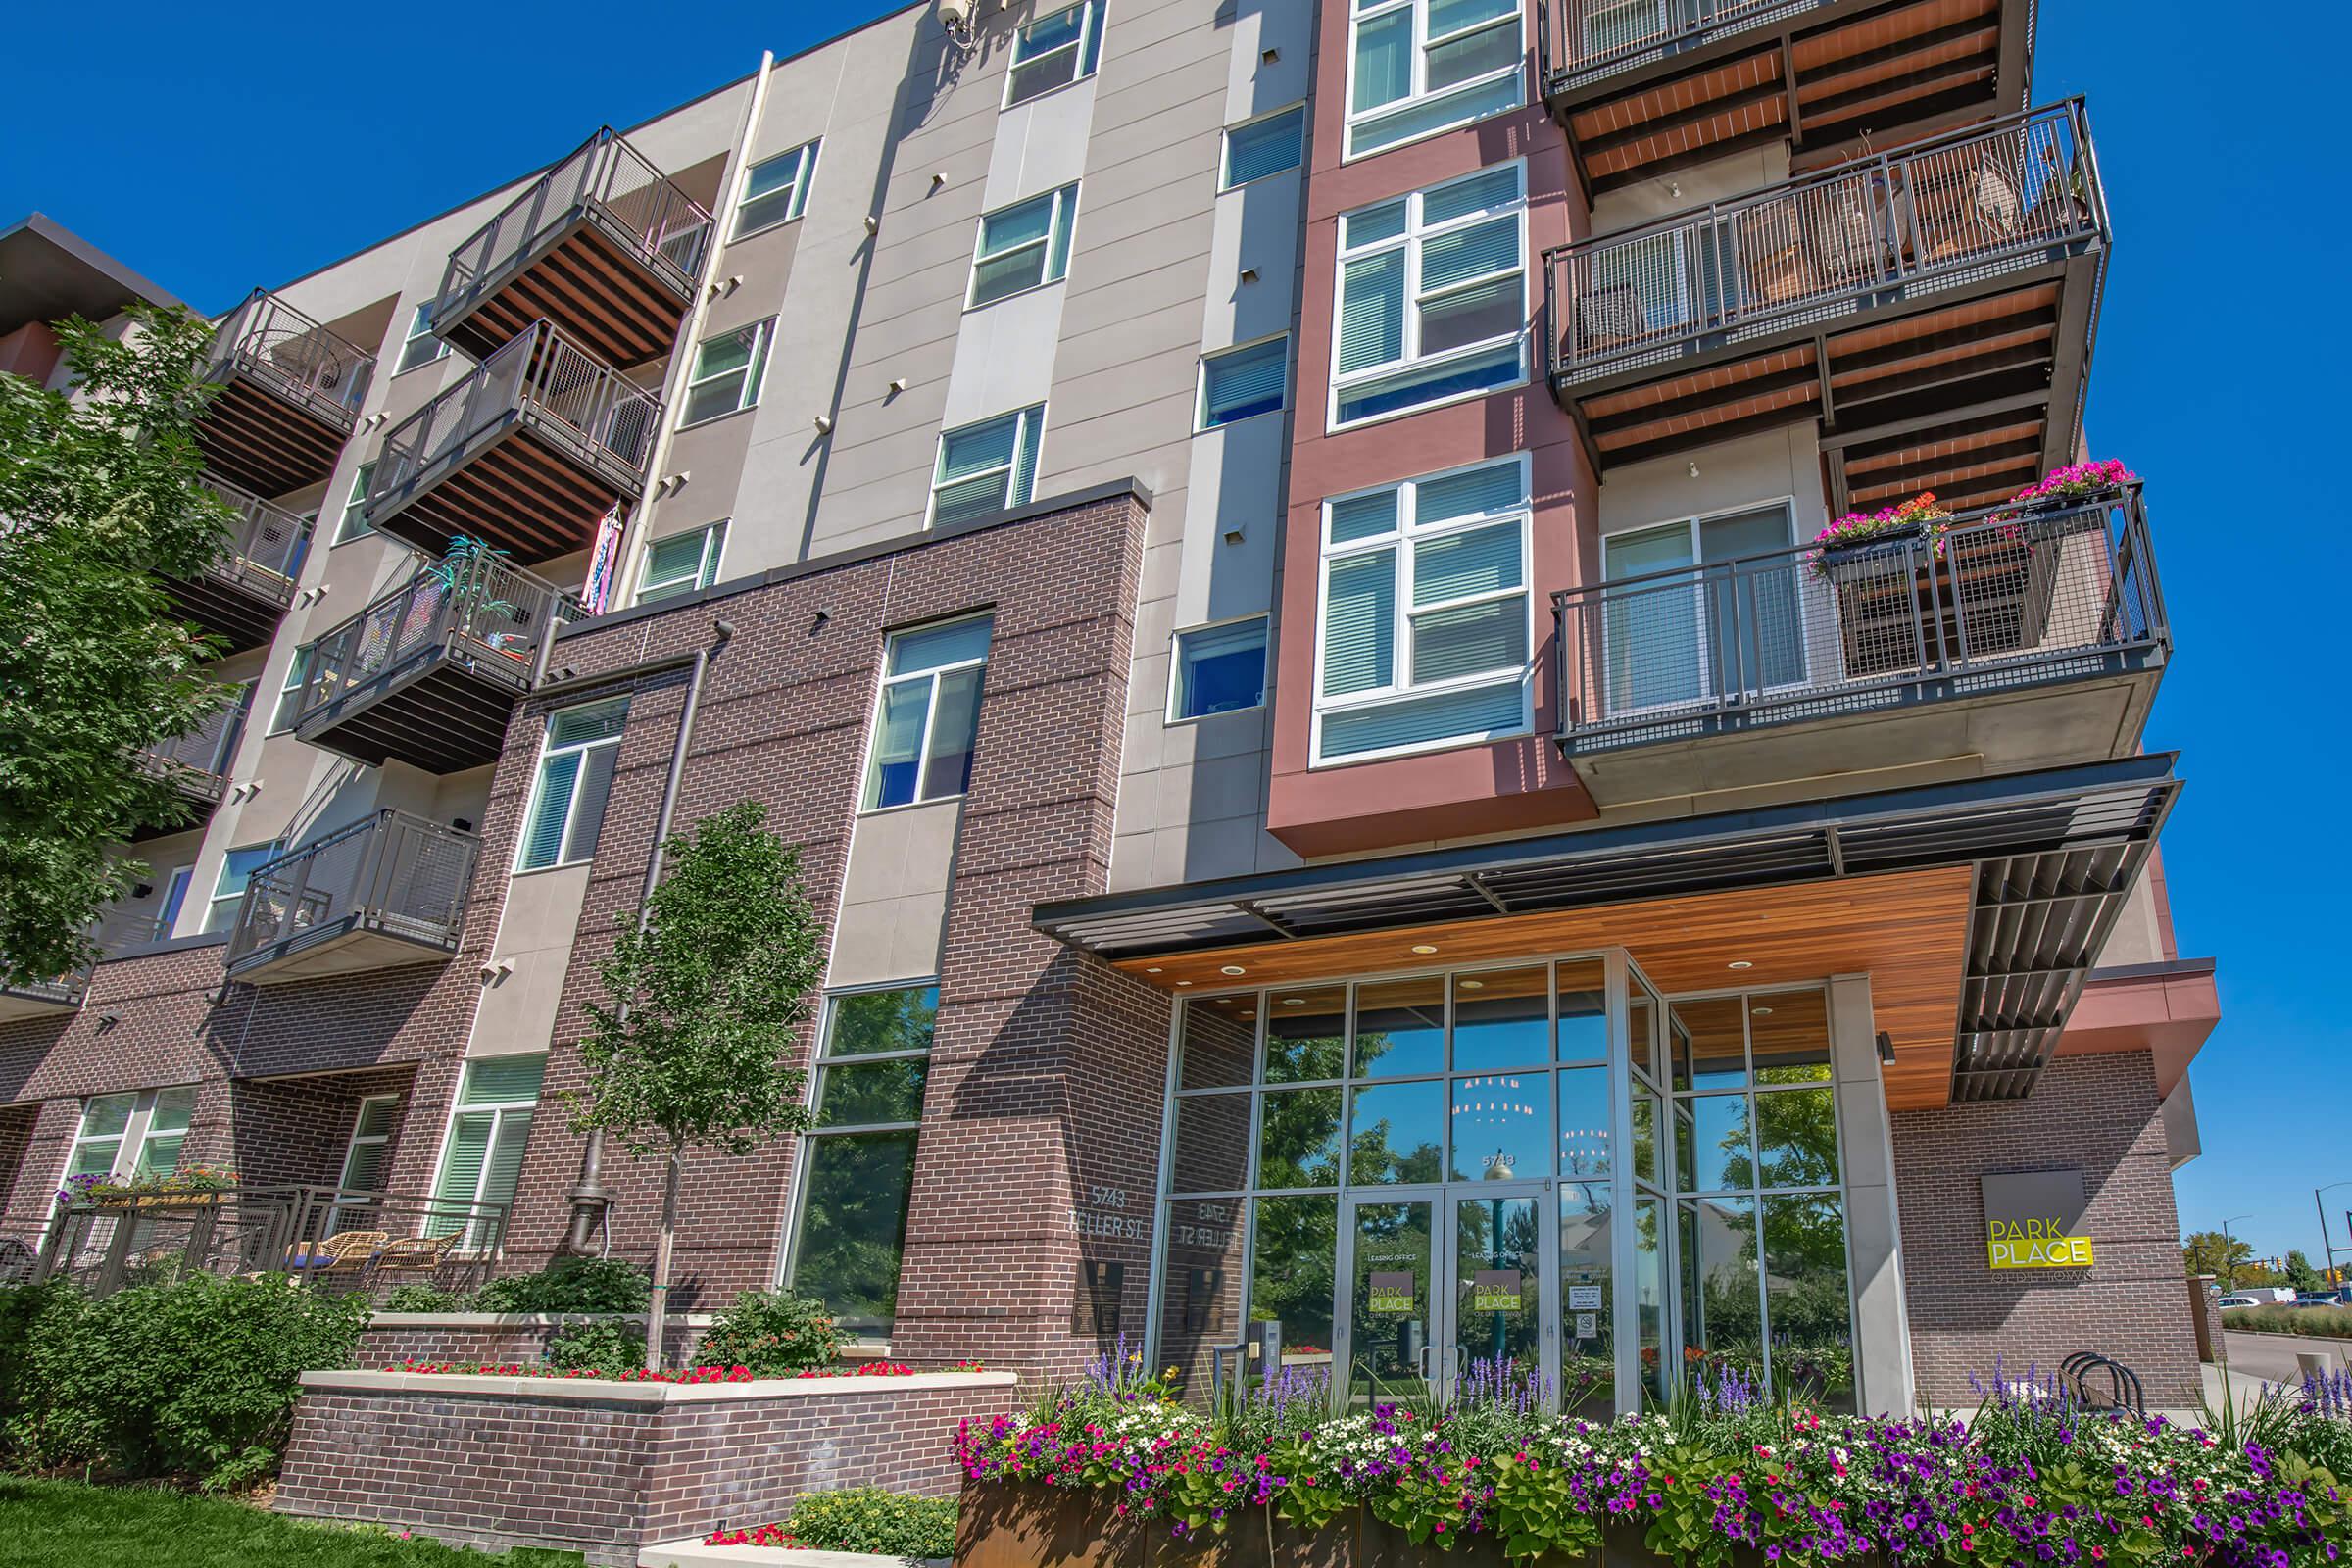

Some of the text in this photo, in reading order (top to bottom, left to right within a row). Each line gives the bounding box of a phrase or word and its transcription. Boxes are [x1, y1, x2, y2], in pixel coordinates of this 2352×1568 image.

[1482, 1155, 1514, 1167] 5743
[1092, 1186, 1125, 1208] 5743
[1068, 1210, 1143, 1239] TELLER ST.
[1990, 1217, 2064, 1241] PARK
[1992, 1240, 2088, 1265] PLACE
[1371, 1286, 1403, 1298] PARK
[1476, 1285, 1509, 1297] PARK
[1370, 1298, 1411, 1311] PLACE
[1476, 1296, 1519, 1309] PLACE
